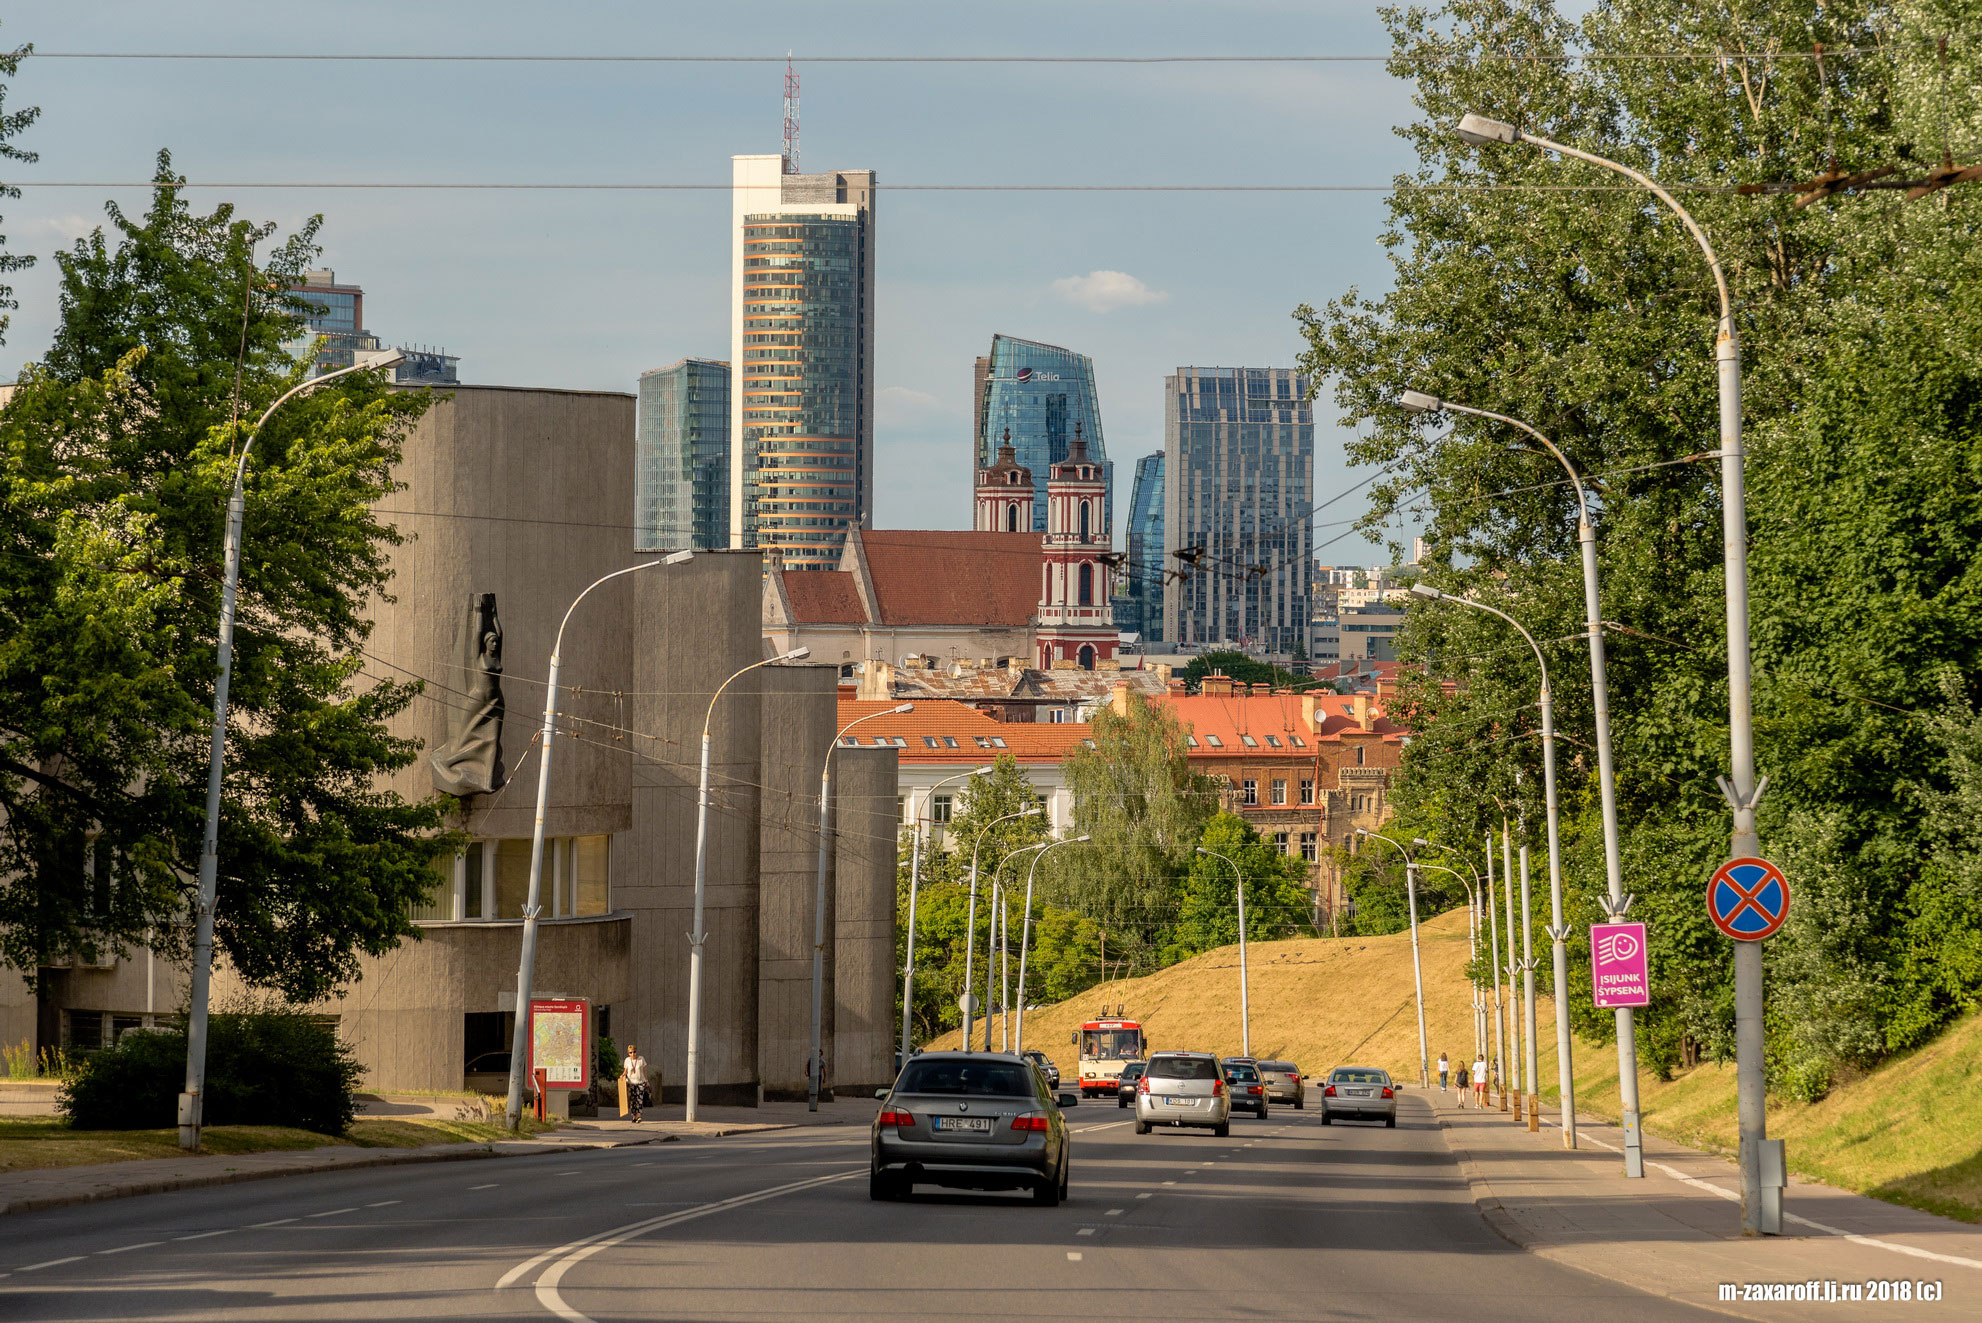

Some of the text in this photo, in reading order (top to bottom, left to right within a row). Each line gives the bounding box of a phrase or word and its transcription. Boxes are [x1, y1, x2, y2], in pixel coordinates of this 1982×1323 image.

[1036, 371, 1060, 381] Telia
[1600, 974, 1640, 985] ĮSIJUNK
[941, 1118, 987, 1129] HRE 491
